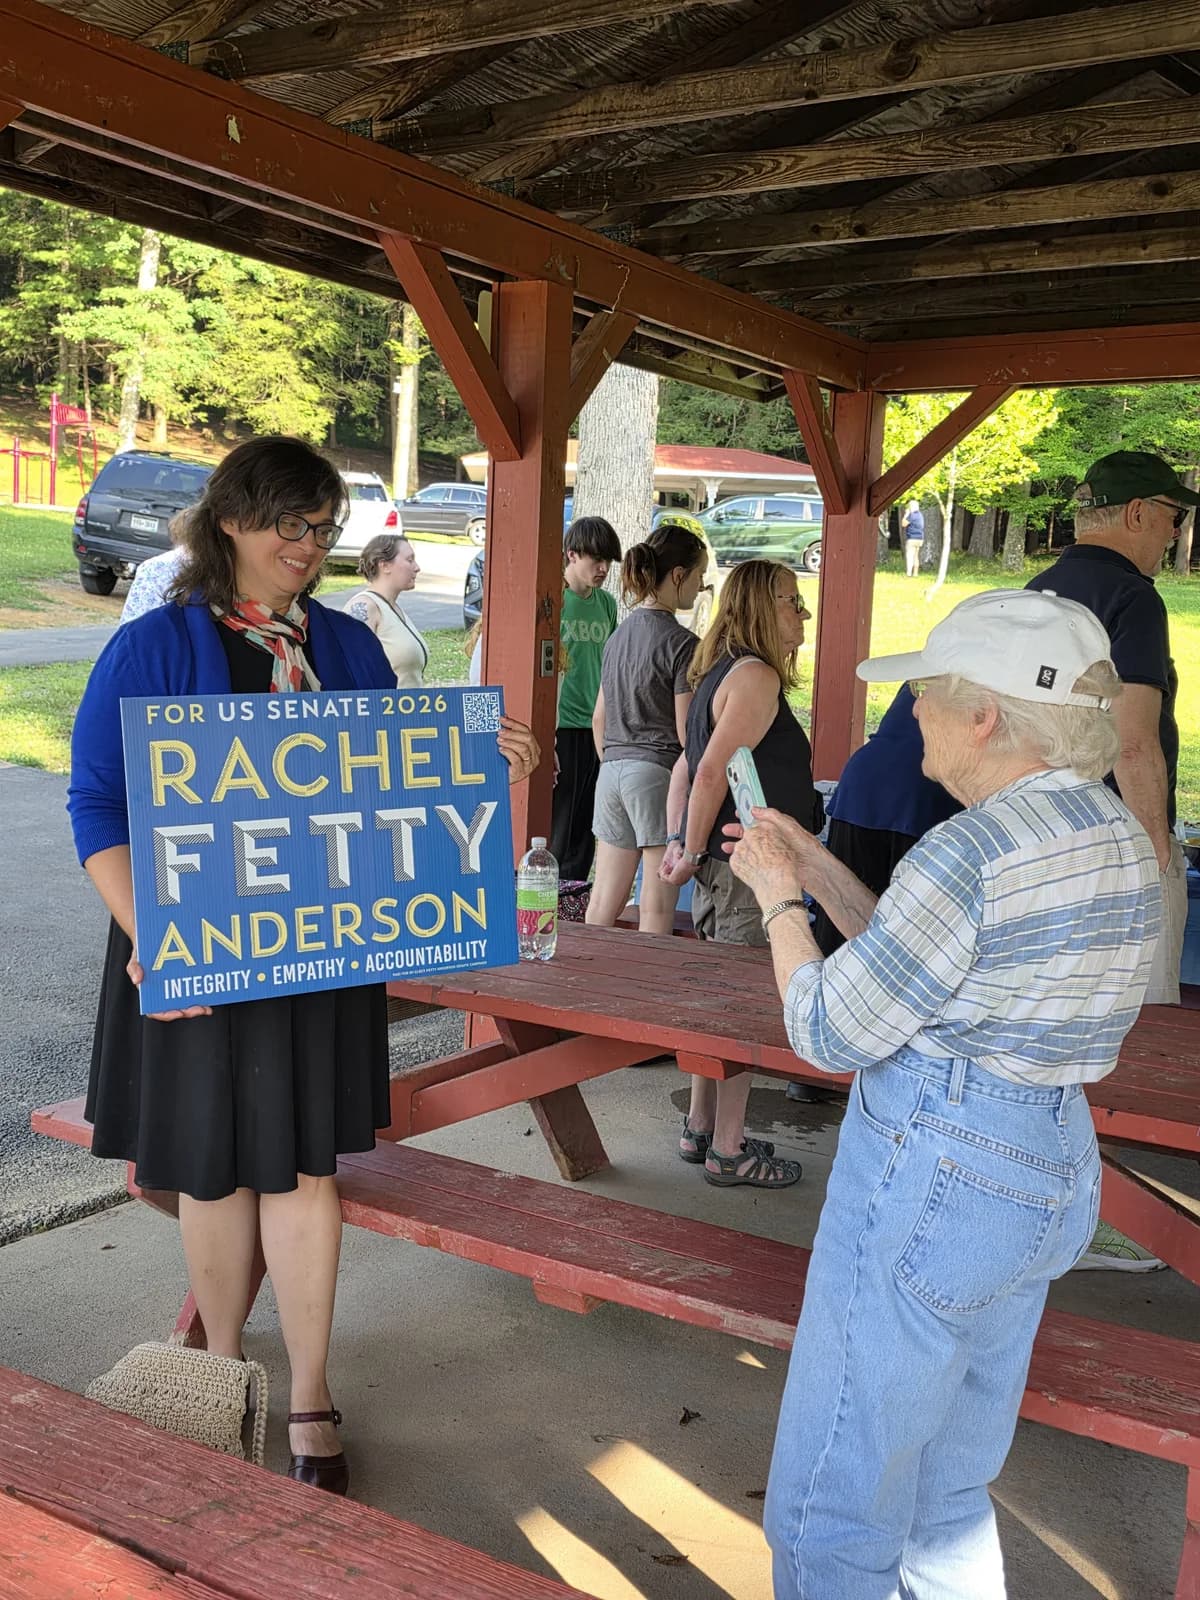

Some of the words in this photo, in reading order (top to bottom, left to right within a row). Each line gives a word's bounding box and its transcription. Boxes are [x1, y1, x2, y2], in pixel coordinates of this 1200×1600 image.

[146, 703, 205, 725] FOR
[218, 700, 255, 722] US
[267, 697, 370, 720] SENATE
[381, 695, 448, 716] 2026
[149, 726, 486, 807] RACHEL
[152, 801, 498, 906] FETTY
[152, 887, 487, 971] ANDERSON
[164, 969, 251, 999] INTEGRITY
[272, 957, 346, 985] EMPATHY
[365, 939, 488, 973] ACCOUNTABILITY
